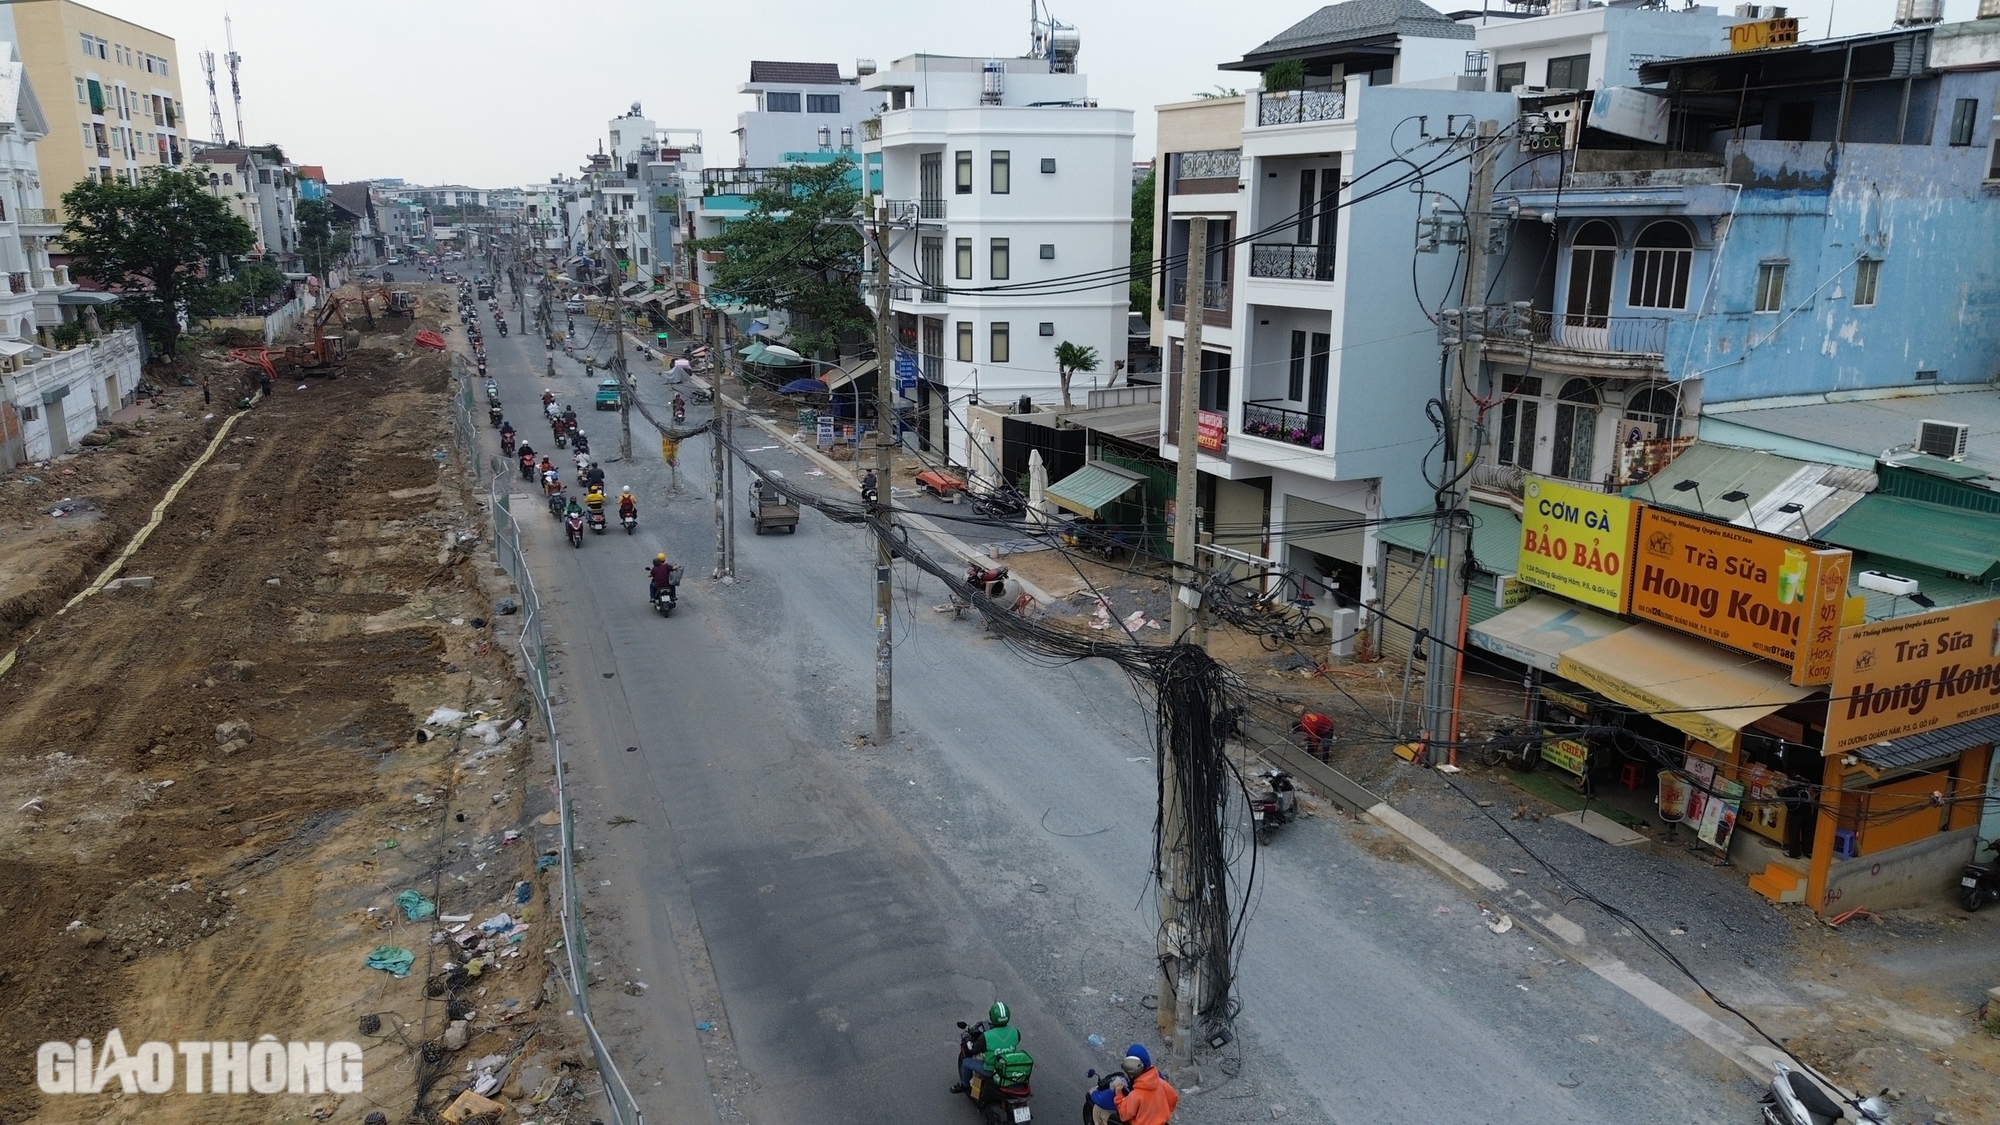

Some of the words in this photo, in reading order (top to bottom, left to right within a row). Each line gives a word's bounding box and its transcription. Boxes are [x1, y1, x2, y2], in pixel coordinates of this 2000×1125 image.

[1539, 499, 1579, 524] CƠM
[1584, 509, 1610, 532] GÀ
[1524, 524, 1567, 560] BẢO
[1572, 538, 1620, 576] BẢO
[1684, 545, 1718, 570] Trà
[1724, 556, 1768, 584] Sữa
[1526, 564, 1534, 572] 124
[1552, 571, 1568, 584] Quảng
[1606, 588, 1618, 598] Vấp
[1642, 564, 1720, 618] Hong
[1821, 573, 1845, 590] Baley
[1490, 638, 1504, 654] be
[1810, 648, 1834, 662] Hong
[1894, 638, 1930, 663] Trà
[1936, 631, 1974, 654] Sữa
[1808, 664, 1831, 680] Kong
[1846, 678, 1932, 720] Hong
[1838, 739, 1847, 748] 124
